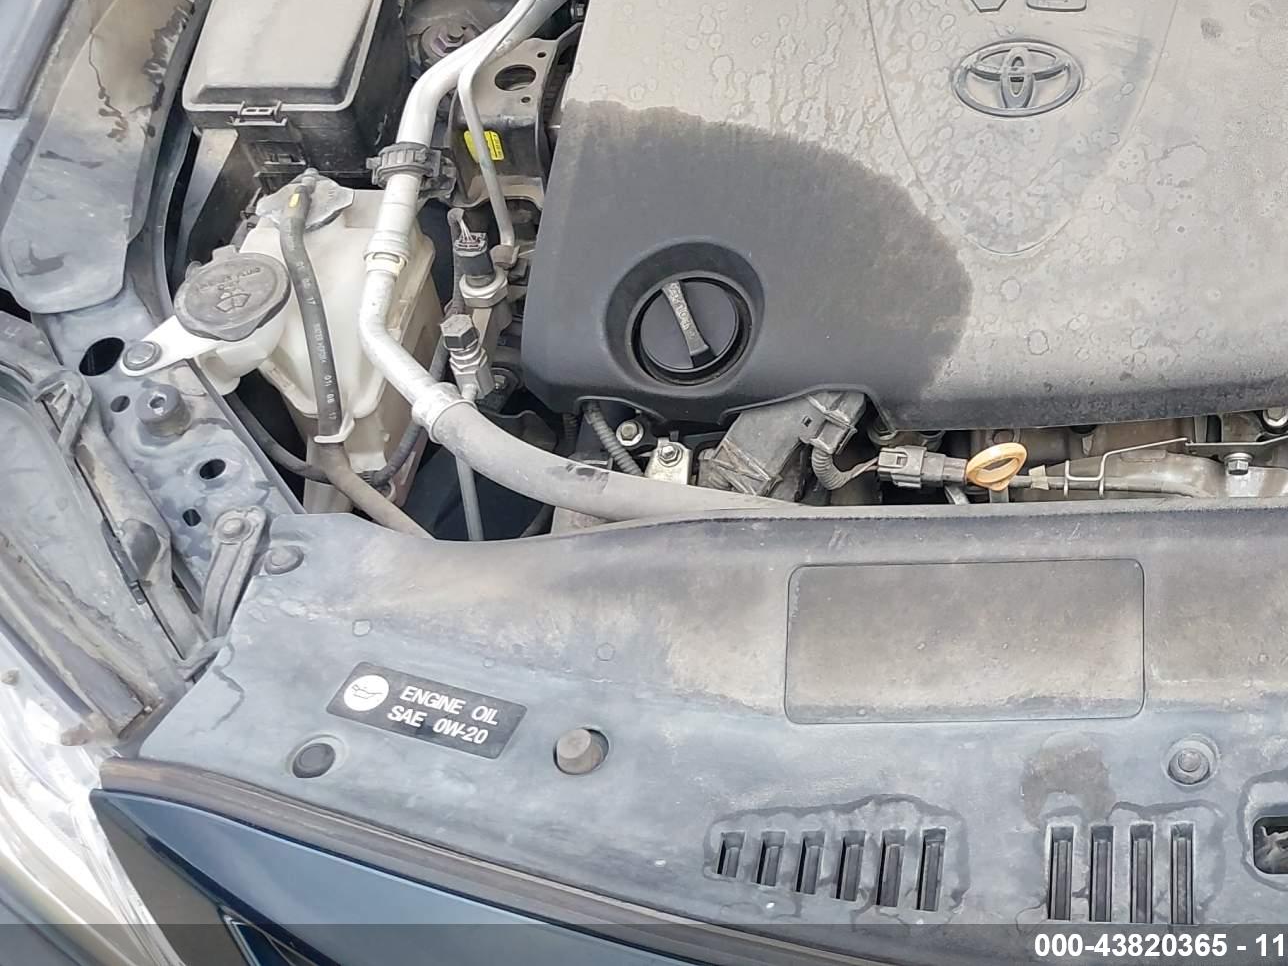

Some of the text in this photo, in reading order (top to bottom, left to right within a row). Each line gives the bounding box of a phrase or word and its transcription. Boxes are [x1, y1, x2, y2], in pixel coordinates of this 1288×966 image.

[387, 705, 490, 745] SAE 0W-20
[399, 685, 498, 726] ENGINE OIL
